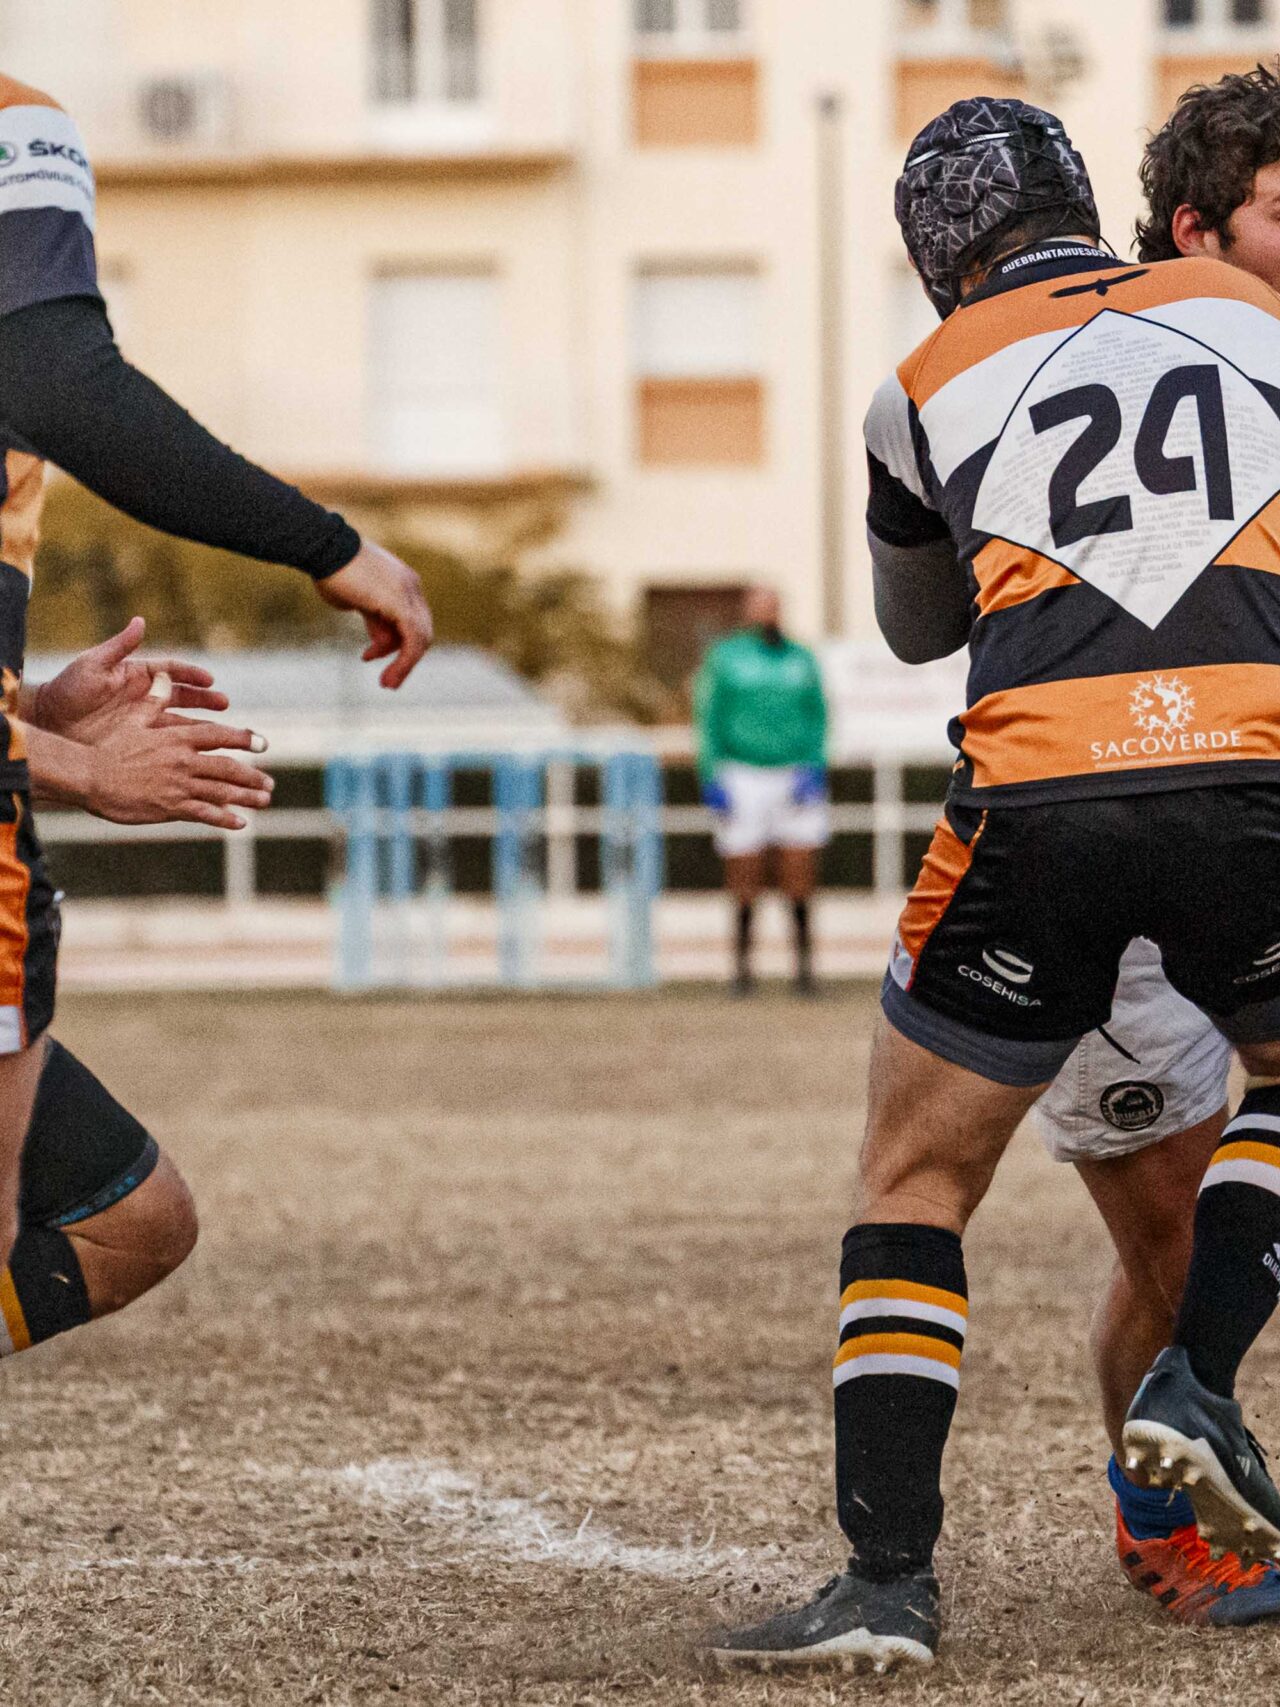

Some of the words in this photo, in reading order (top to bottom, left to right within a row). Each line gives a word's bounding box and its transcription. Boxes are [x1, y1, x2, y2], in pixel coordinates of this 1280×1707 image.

[1001, 246, 1106, 274] QUEBRANTAHUESOS
[1090, 729, 1242, 761] SACOVERDE
[957, 964, 1042, 1007] COSEHISA
